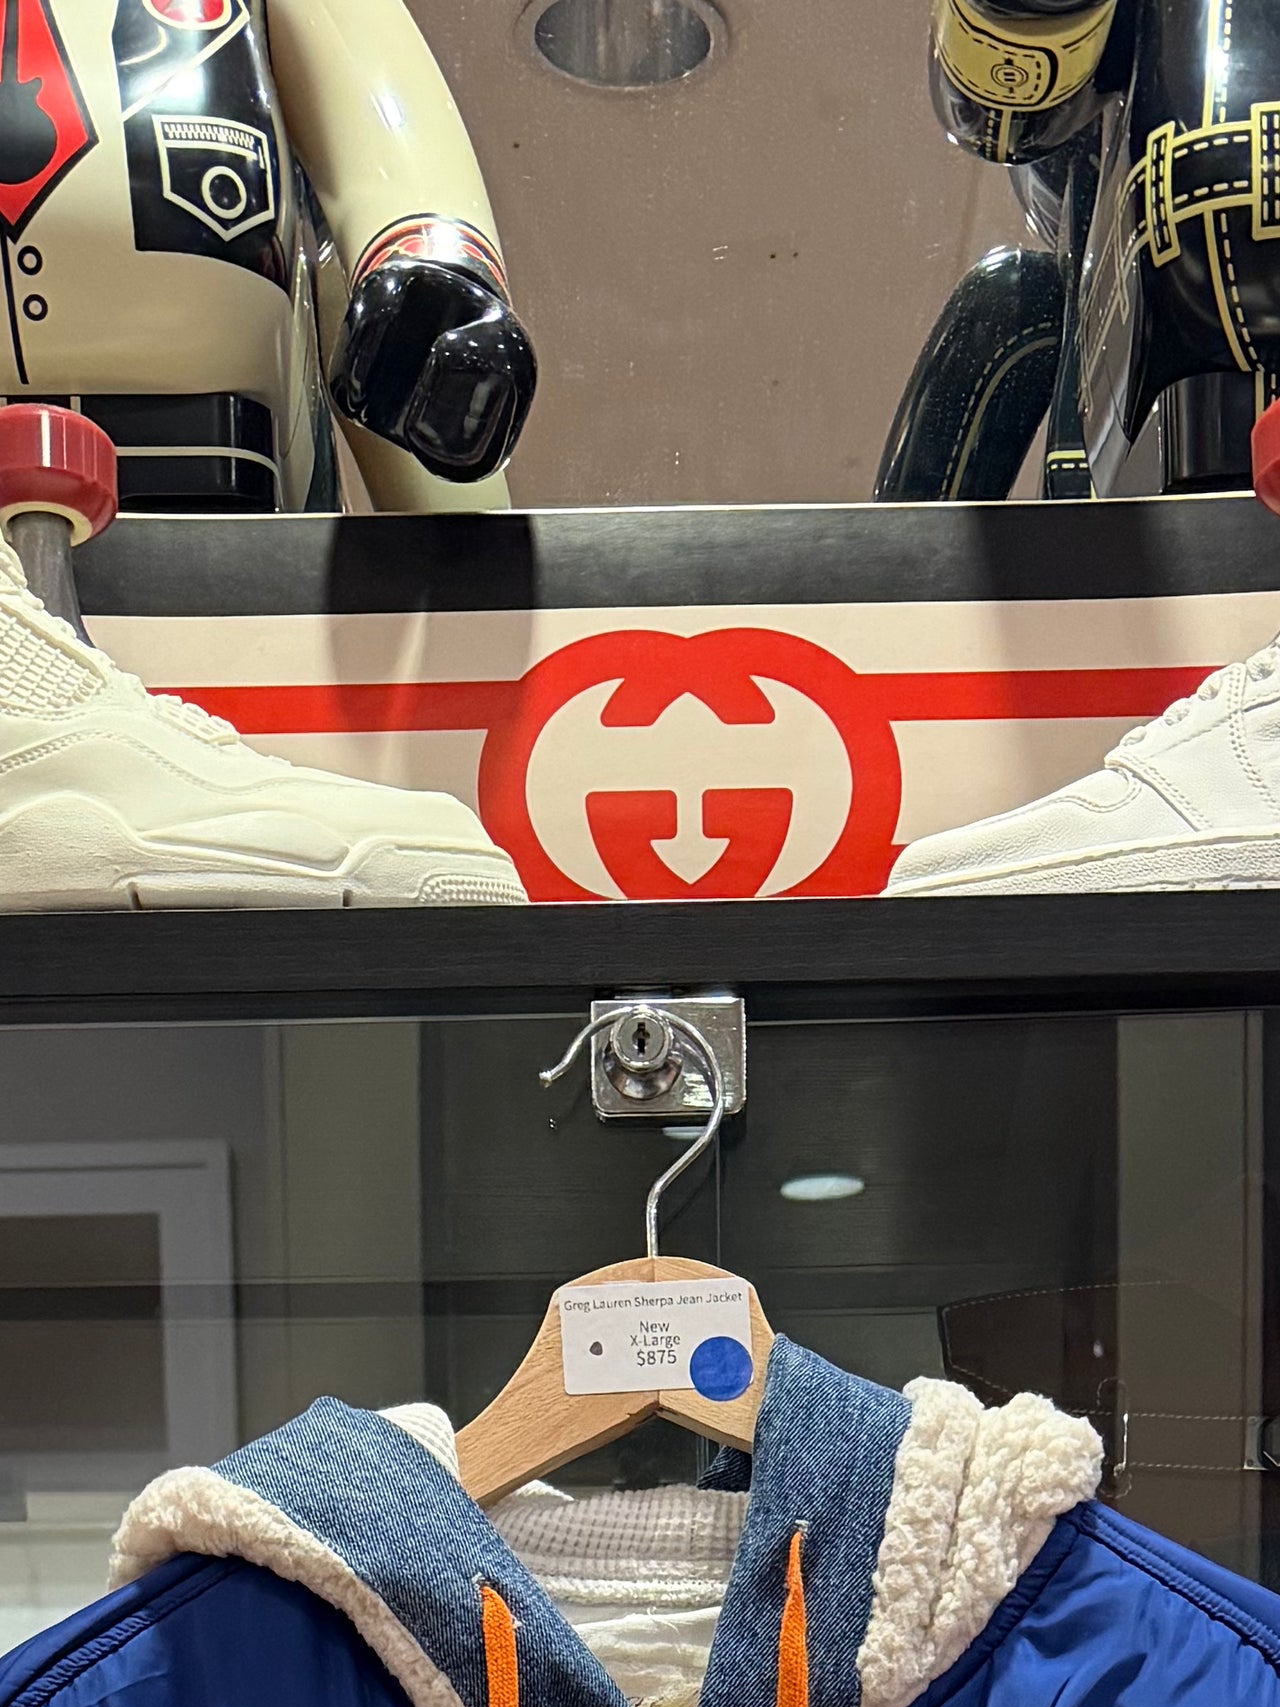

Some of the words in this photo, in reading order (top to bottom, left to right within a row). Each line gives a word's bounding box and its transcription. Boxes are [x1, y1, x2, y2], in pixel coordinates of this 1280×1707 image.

[564, 1300, 591, 1313] Greg
[593, 1299, 632, 1310] Lauren
[634, 1296, 674, 1308] Sherpa
[676, 1295, 703, 1305] Jean
[706, 1291, 742, 1304] Jacket
[639, 1320, 670, 1333] New
[630, 1334, 681, 1349] X-Large
[636, 1349, 677, 1366] $875
